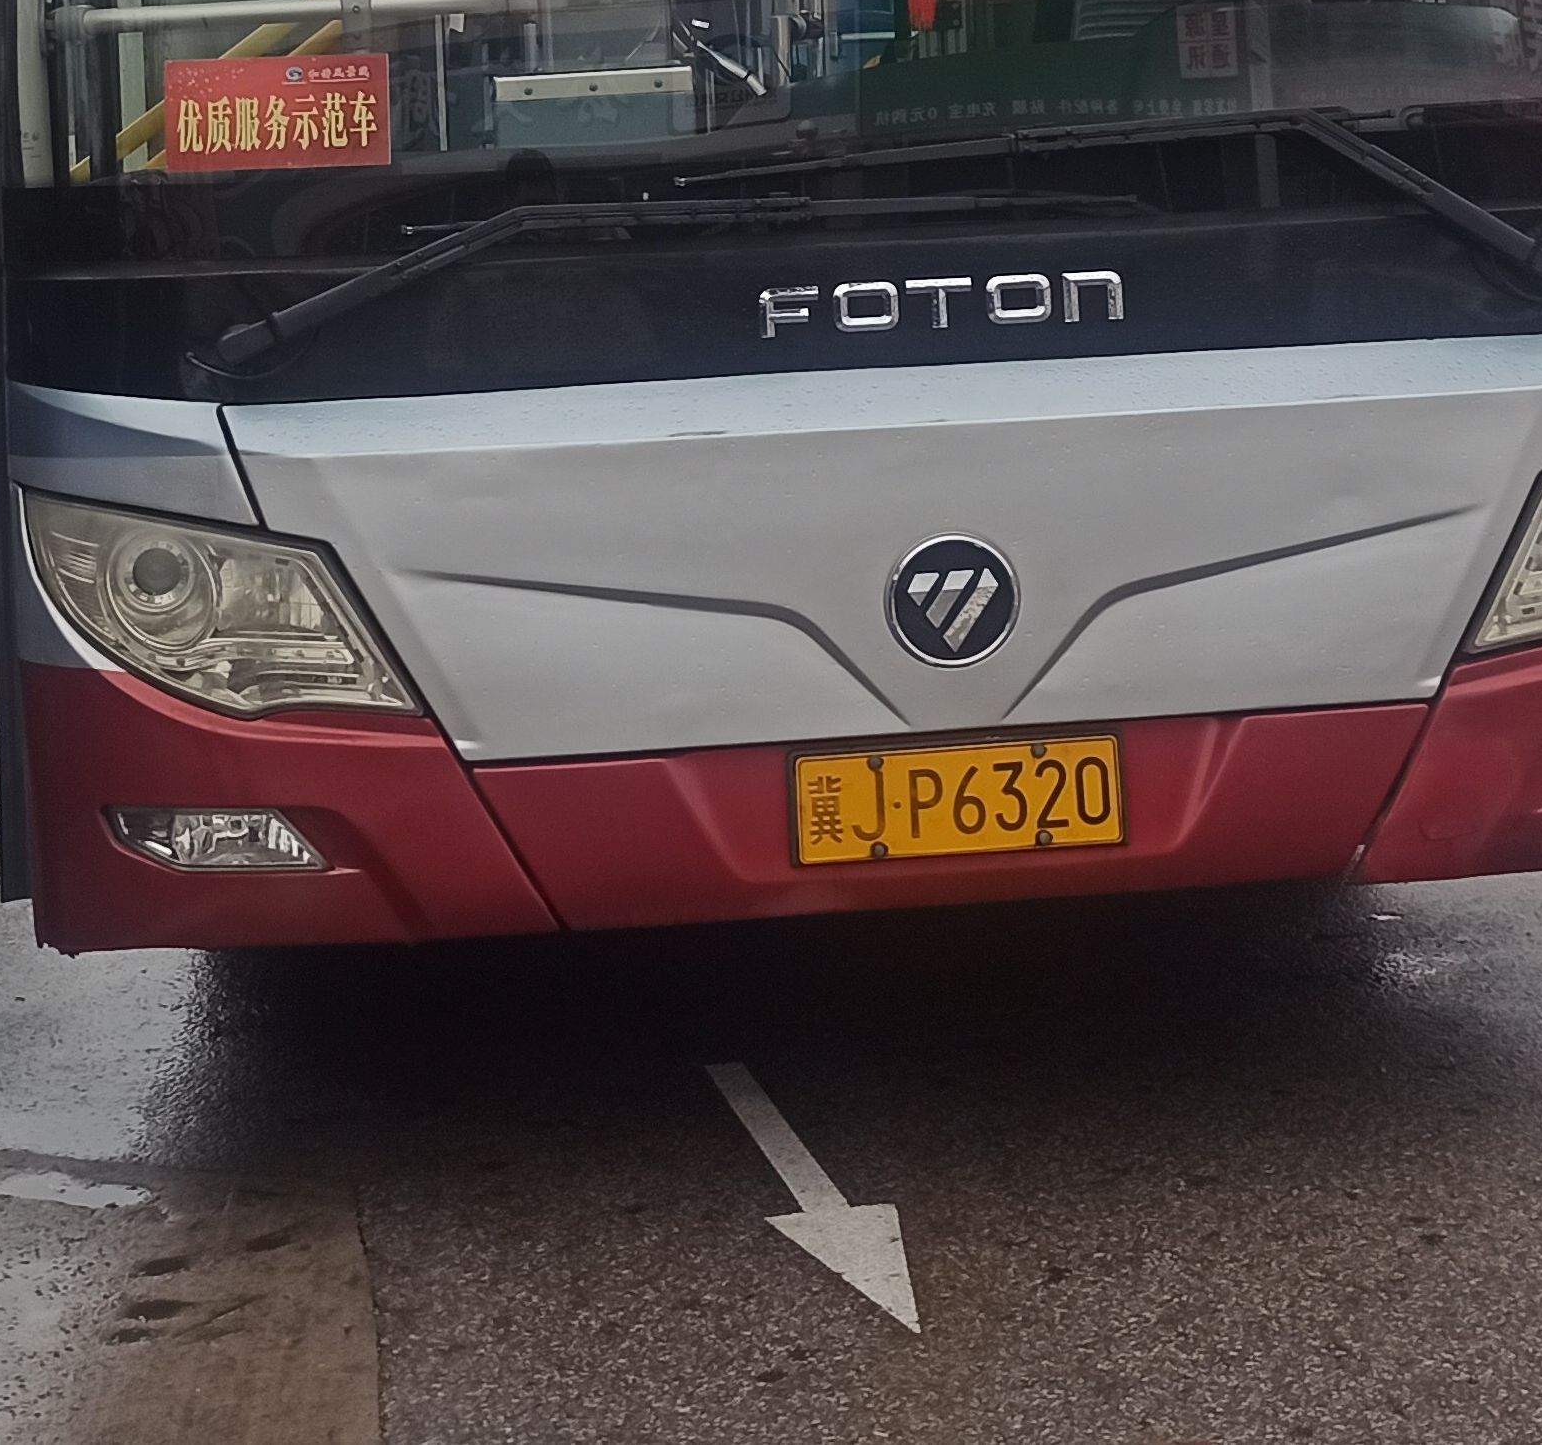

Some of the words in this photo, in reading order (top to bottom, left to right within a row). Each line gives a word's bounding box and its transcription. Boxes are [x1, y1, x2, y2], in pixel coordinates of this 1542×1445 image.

[176, 91, 378, 154] 优质服务示范车
[758, 270, 1124, 338] FOTON
